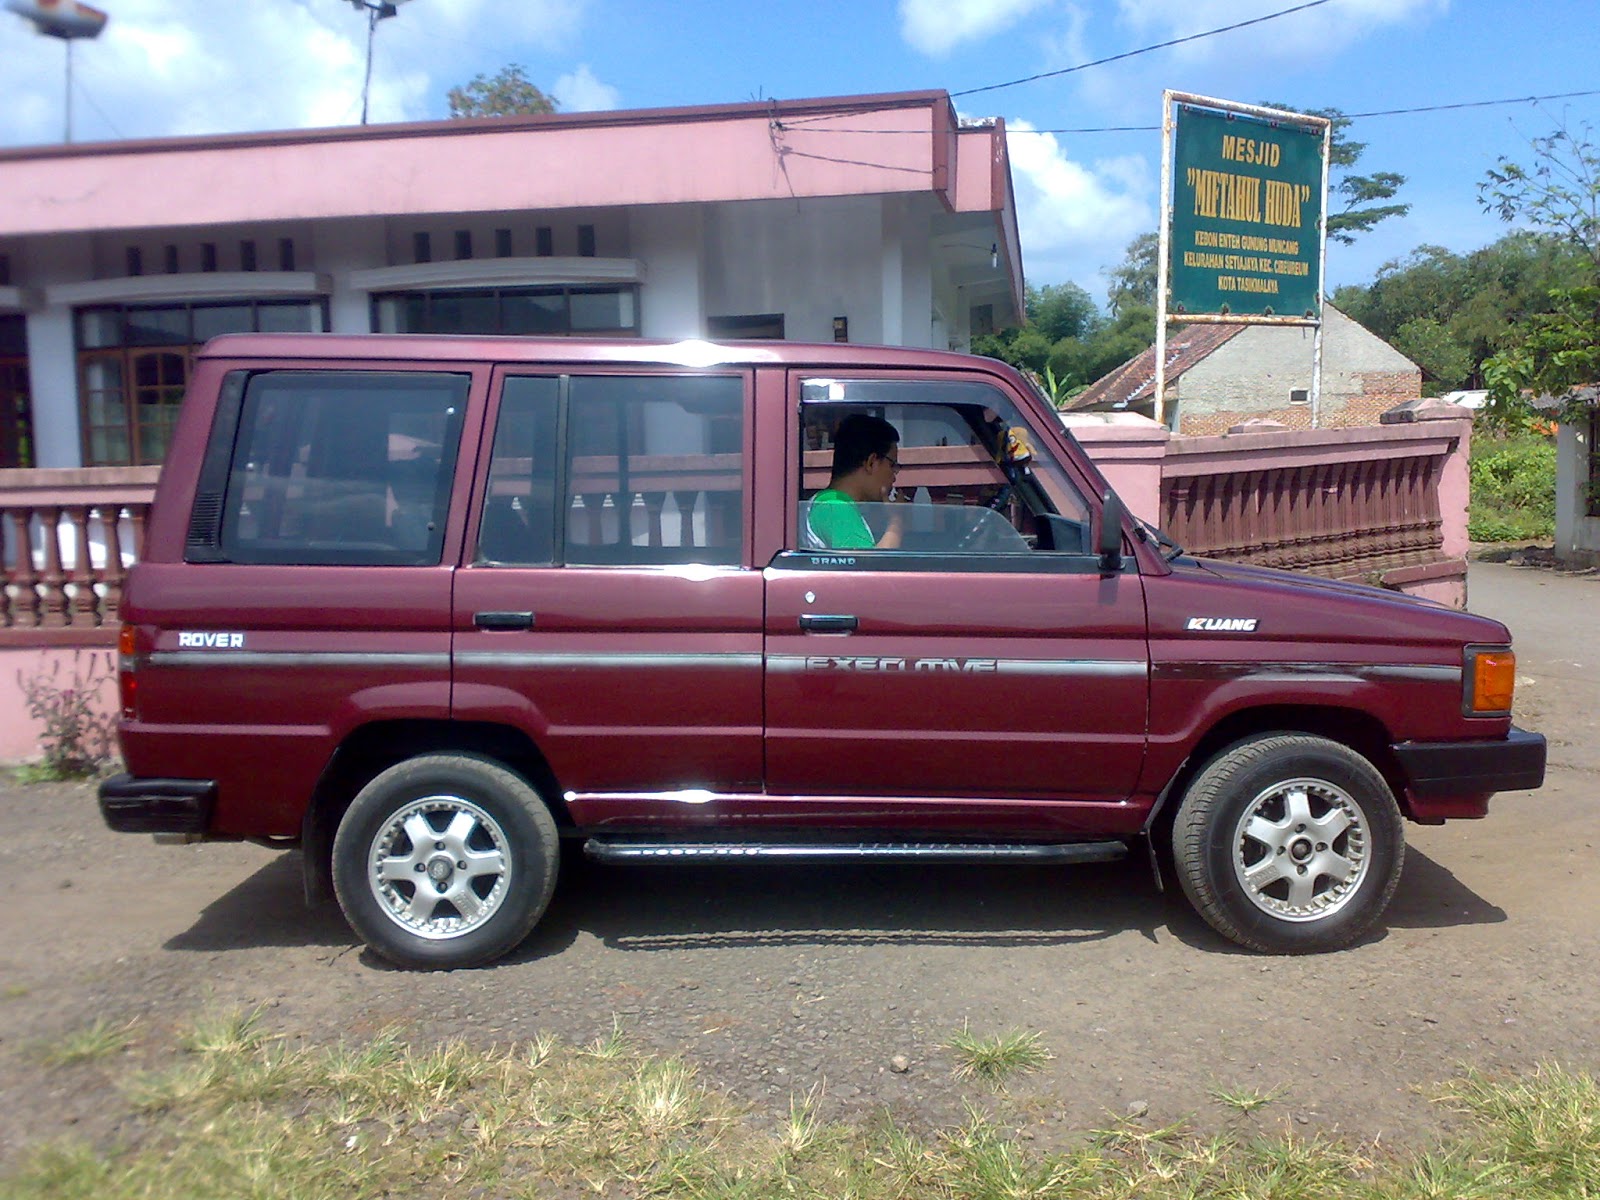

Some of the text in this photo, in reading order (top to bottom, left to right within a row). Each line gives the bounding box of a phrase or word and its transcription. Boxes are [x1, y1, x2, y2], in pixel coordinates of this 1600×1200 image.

[1222, 135, 1280, 167] MESJID
[1187, 167, 1310, 228] "MIFTAHUL HUDA"
[1195, 230, 1218, 247] KEBON
[1219, 232, 1240, 249] ENTEH
[1241, 235, 1268, 252] GUNUNG
[1184, 251, 1224, 269] KELURAHAN
[1218, 275, 1279, 294] KOTA TASIKMALAYA
[178, 632, 244, 647] ROVER
